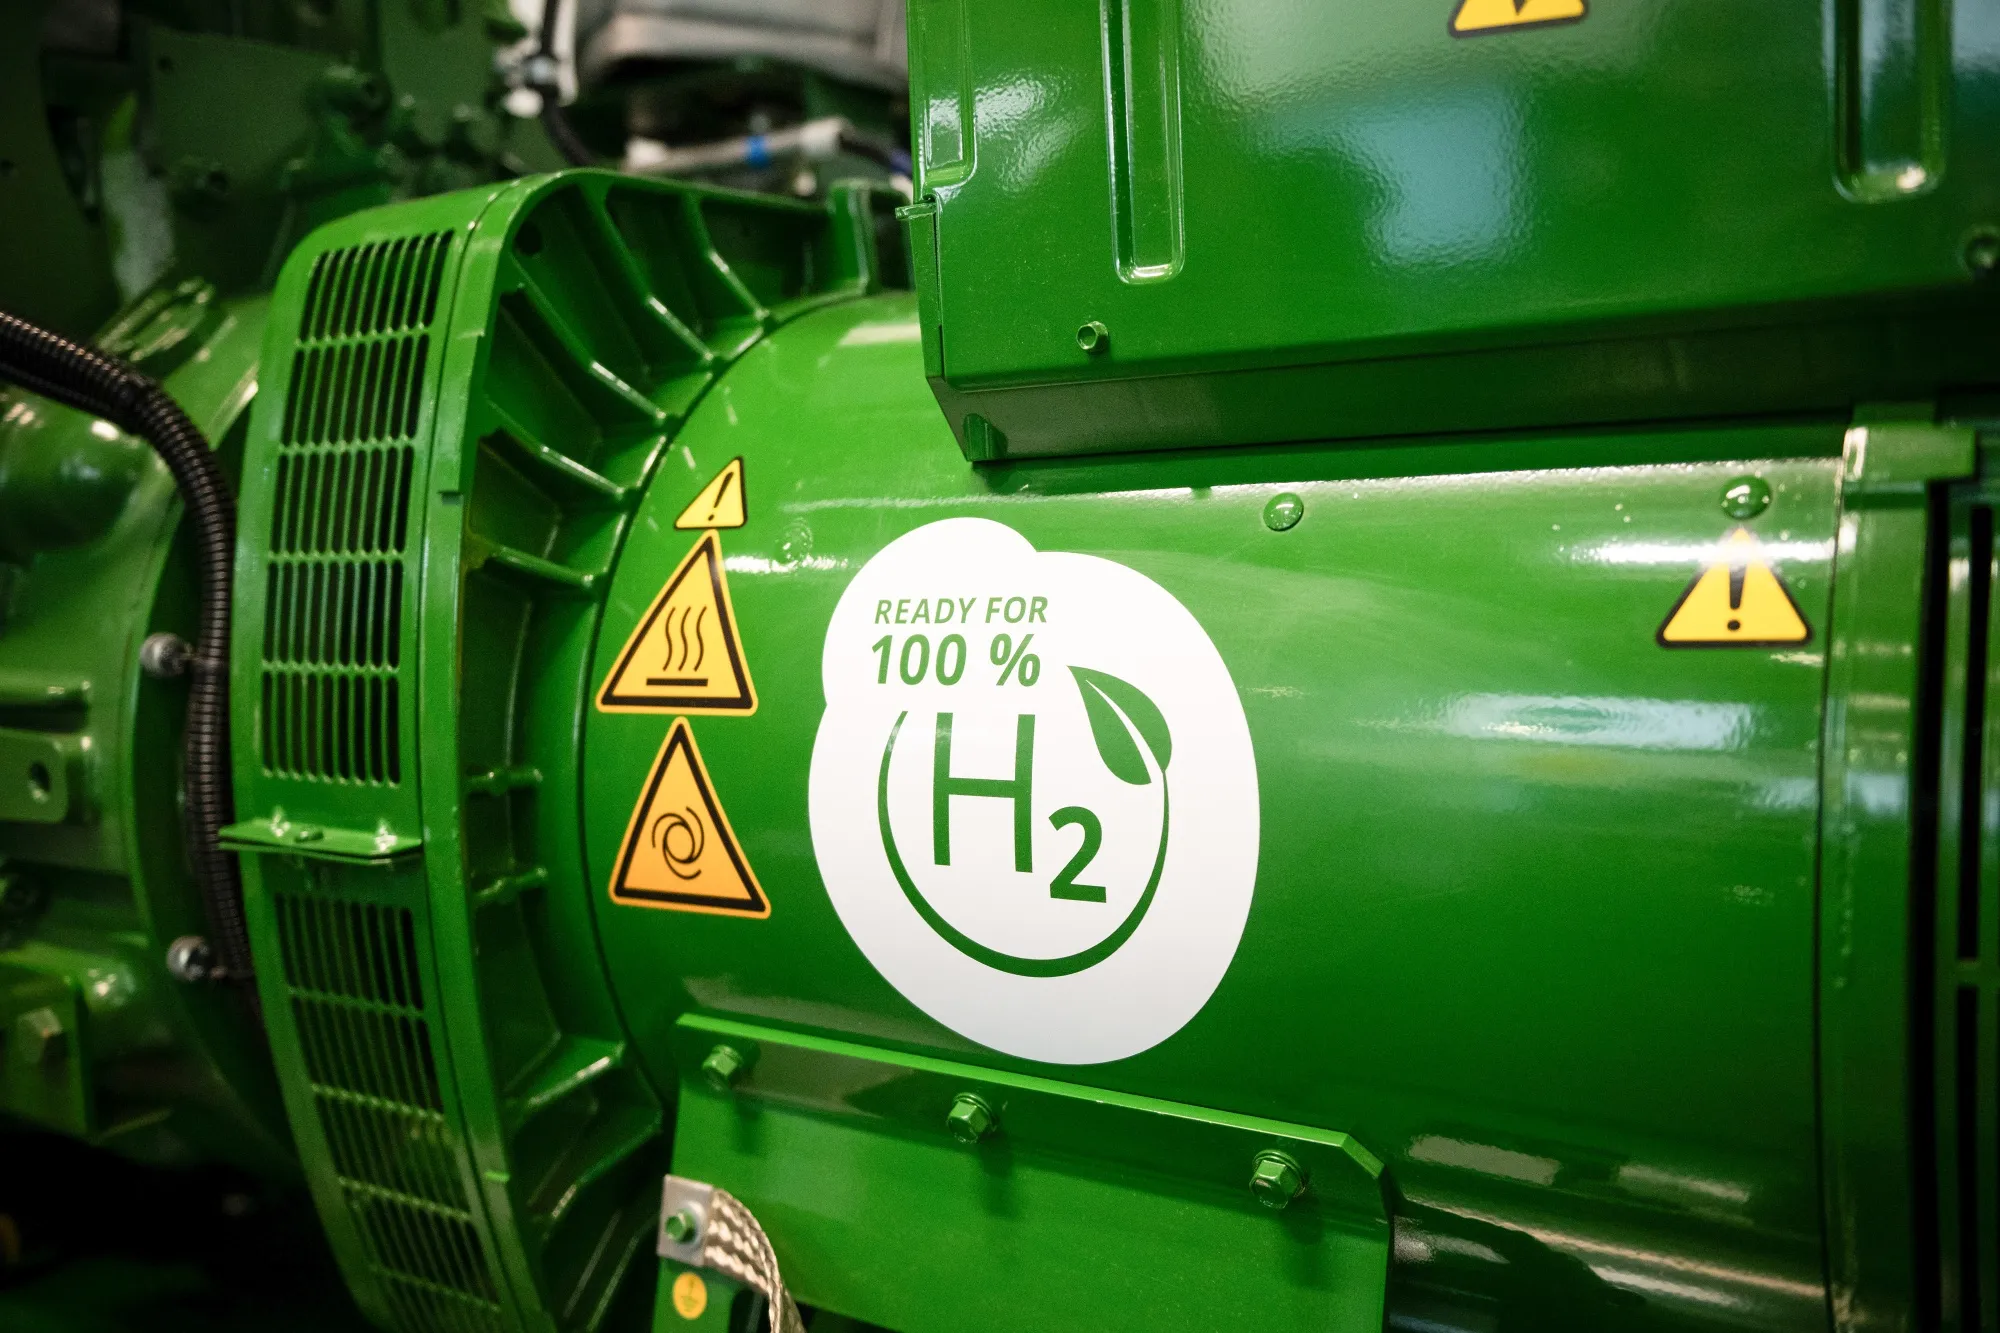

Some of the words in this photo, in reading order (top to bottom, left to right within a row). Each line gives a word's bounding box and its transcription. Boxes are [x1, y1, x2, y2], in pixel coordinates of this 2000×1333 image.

[874, 598, 976, 624] READY
[985, 596, 1048, 623] FOR
[871, 633, 967, 686] 100
[989, 633, 1041, 687] %
